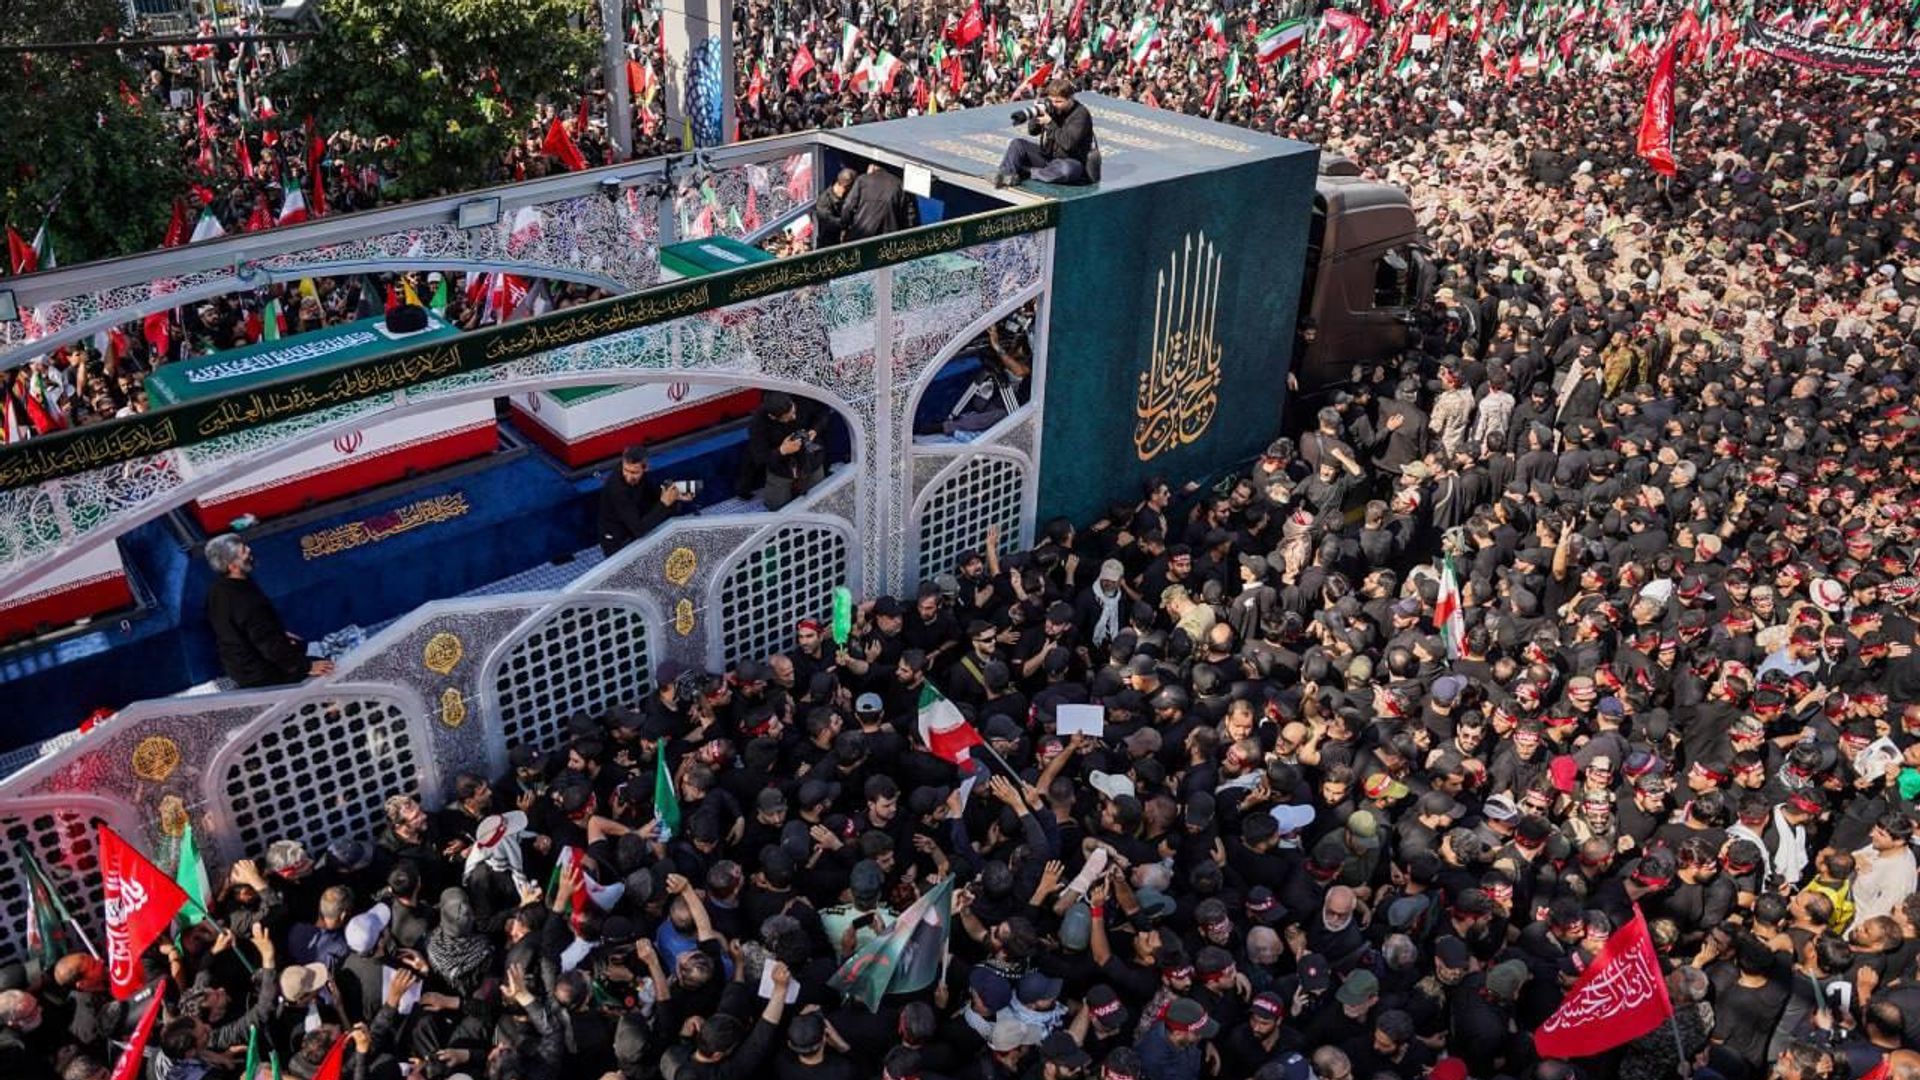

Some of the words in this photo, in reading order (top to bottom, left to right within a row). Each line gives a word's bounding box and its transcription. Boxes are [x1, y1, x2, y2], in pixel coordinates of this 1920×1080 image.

[1858, 49, 1886, 60] خامنه
[1886, 64, 1909, 77] امام
[683, 284, 709, 307] السلام
[390, 356, 420, 384] عليك
[414, 345, 461, 378] السلام
[293, 384, 333, 406] سيدة
[333, 370, 367, 399] فاطمة
[198, 395, 265, 435] العالمين
[266, 392, 295, 413] نساء
[127, 416, 177, 455] السلام
